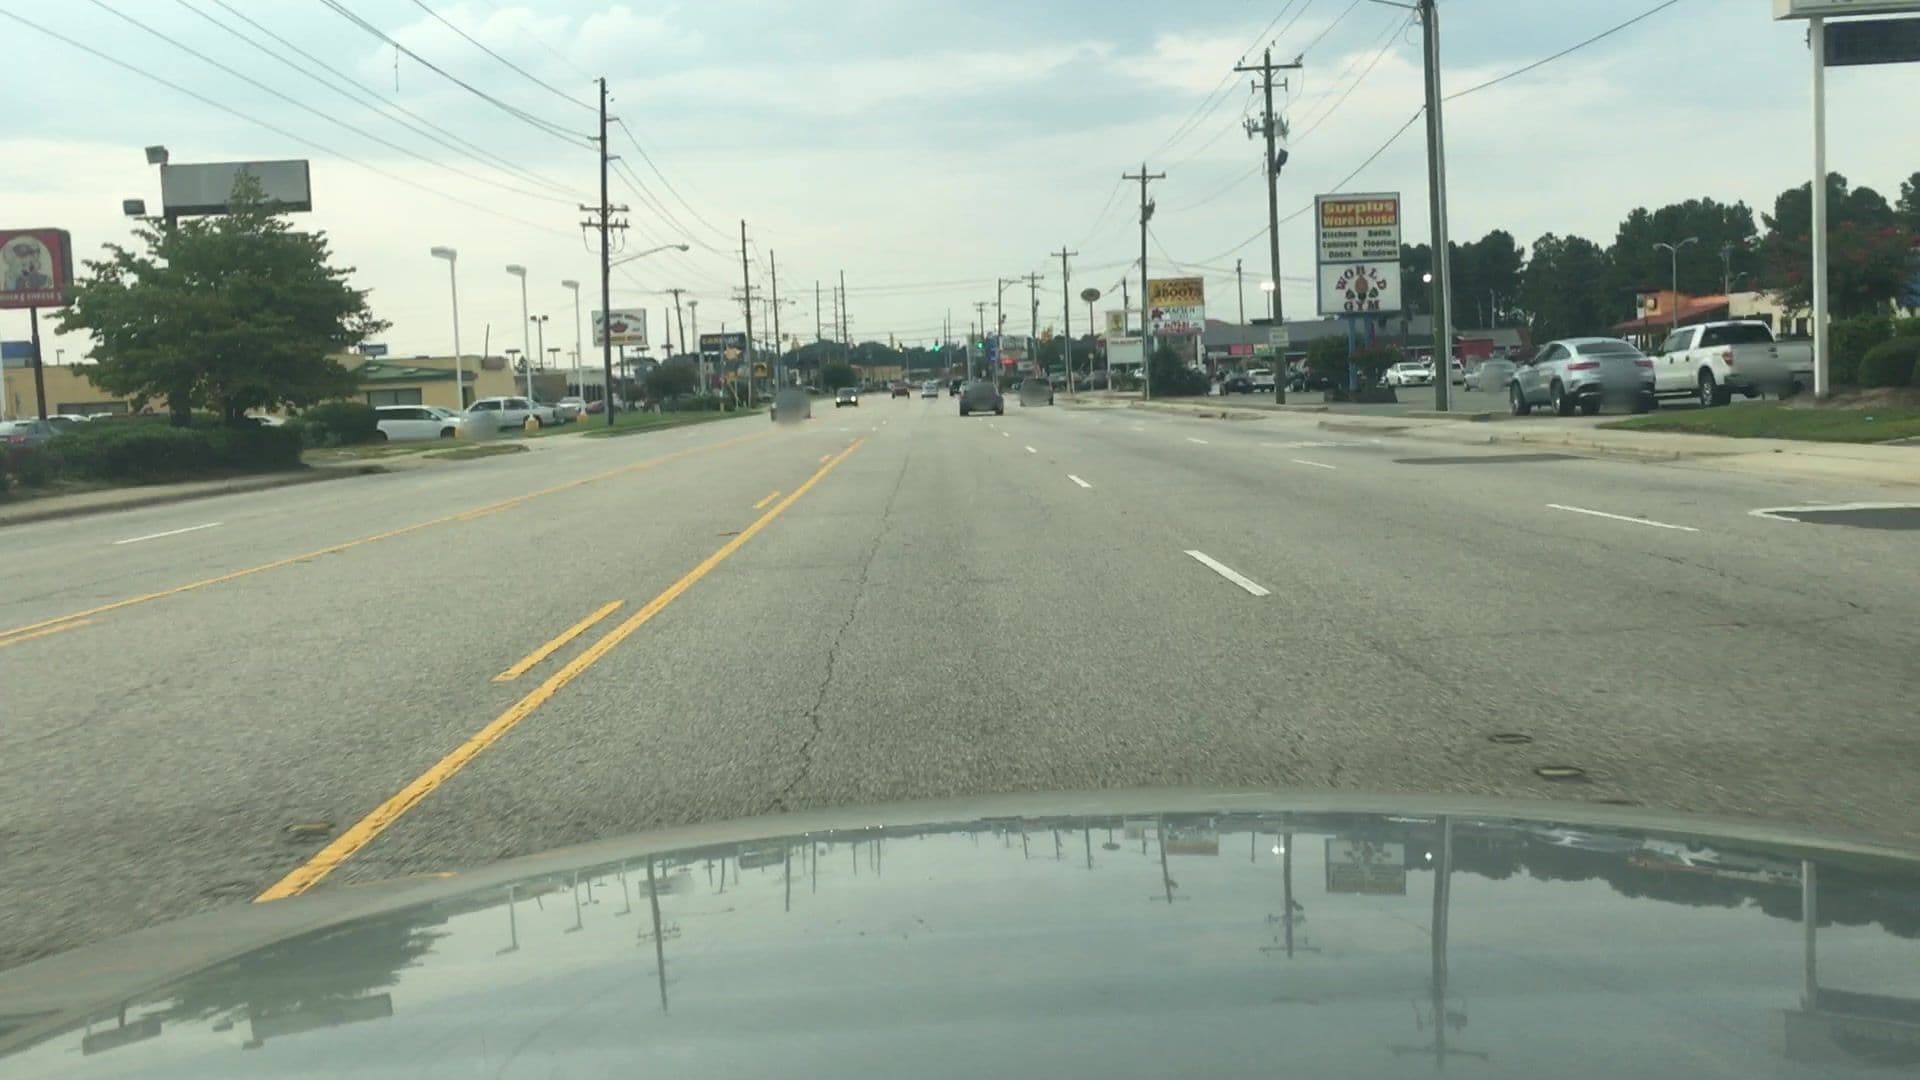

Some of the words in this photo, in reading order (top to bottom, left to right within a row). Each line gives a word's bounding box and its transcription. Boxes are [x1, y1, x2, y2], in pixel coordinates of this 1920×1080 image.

[1324, 201, 1394, 216] Surplus
[1324, 213, 1396, 226] Warehouse
[1335, 265, 1387, 291] WORLD
[1344, 300, 1379, 312] GYM
